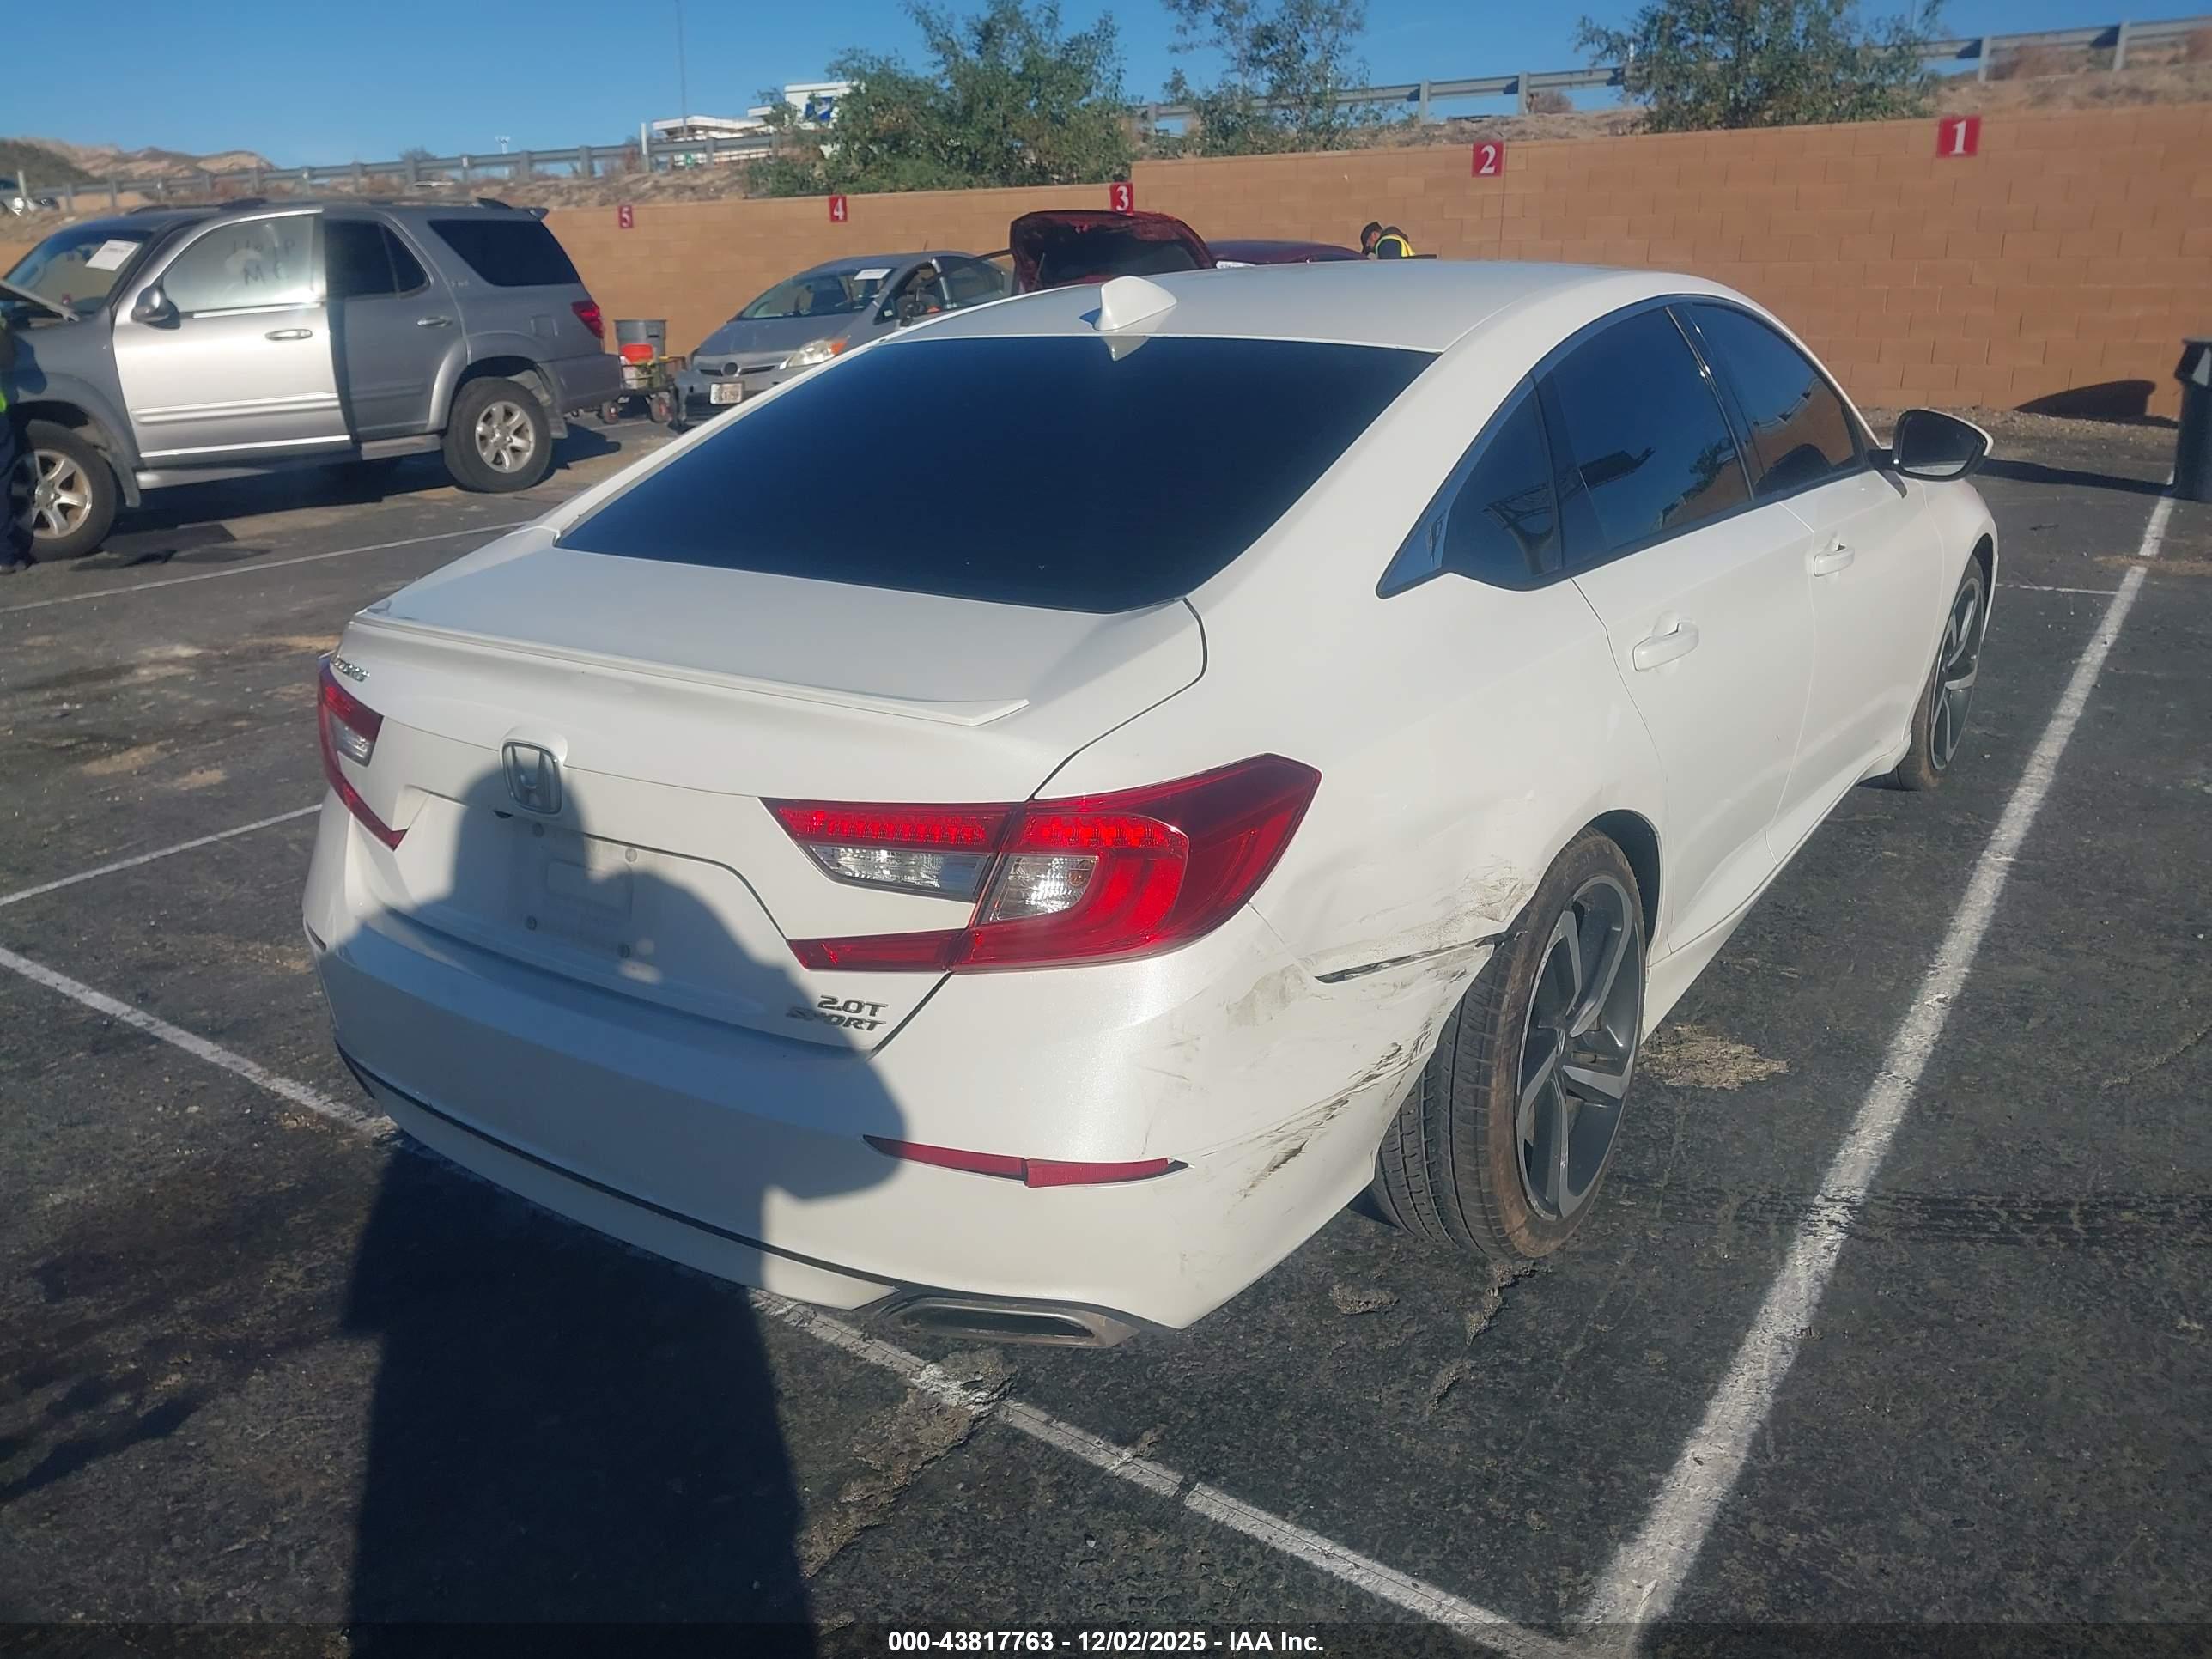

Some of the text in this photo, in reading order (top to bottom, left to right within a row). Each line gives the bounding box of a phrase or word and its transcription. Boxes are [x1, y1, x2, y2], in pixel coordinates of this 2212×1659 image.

[1953, 120, 1966, 154] 1
[1480, 145, 1497, 174] 2
[833, 198, 844, 220] 4
[1116, 185, 1130, 211] 3
[622, 206, 632, 228] 5
[786, 1006, 887, 1032] SPORT
[817, 994, 889, 1018] 2.0T
